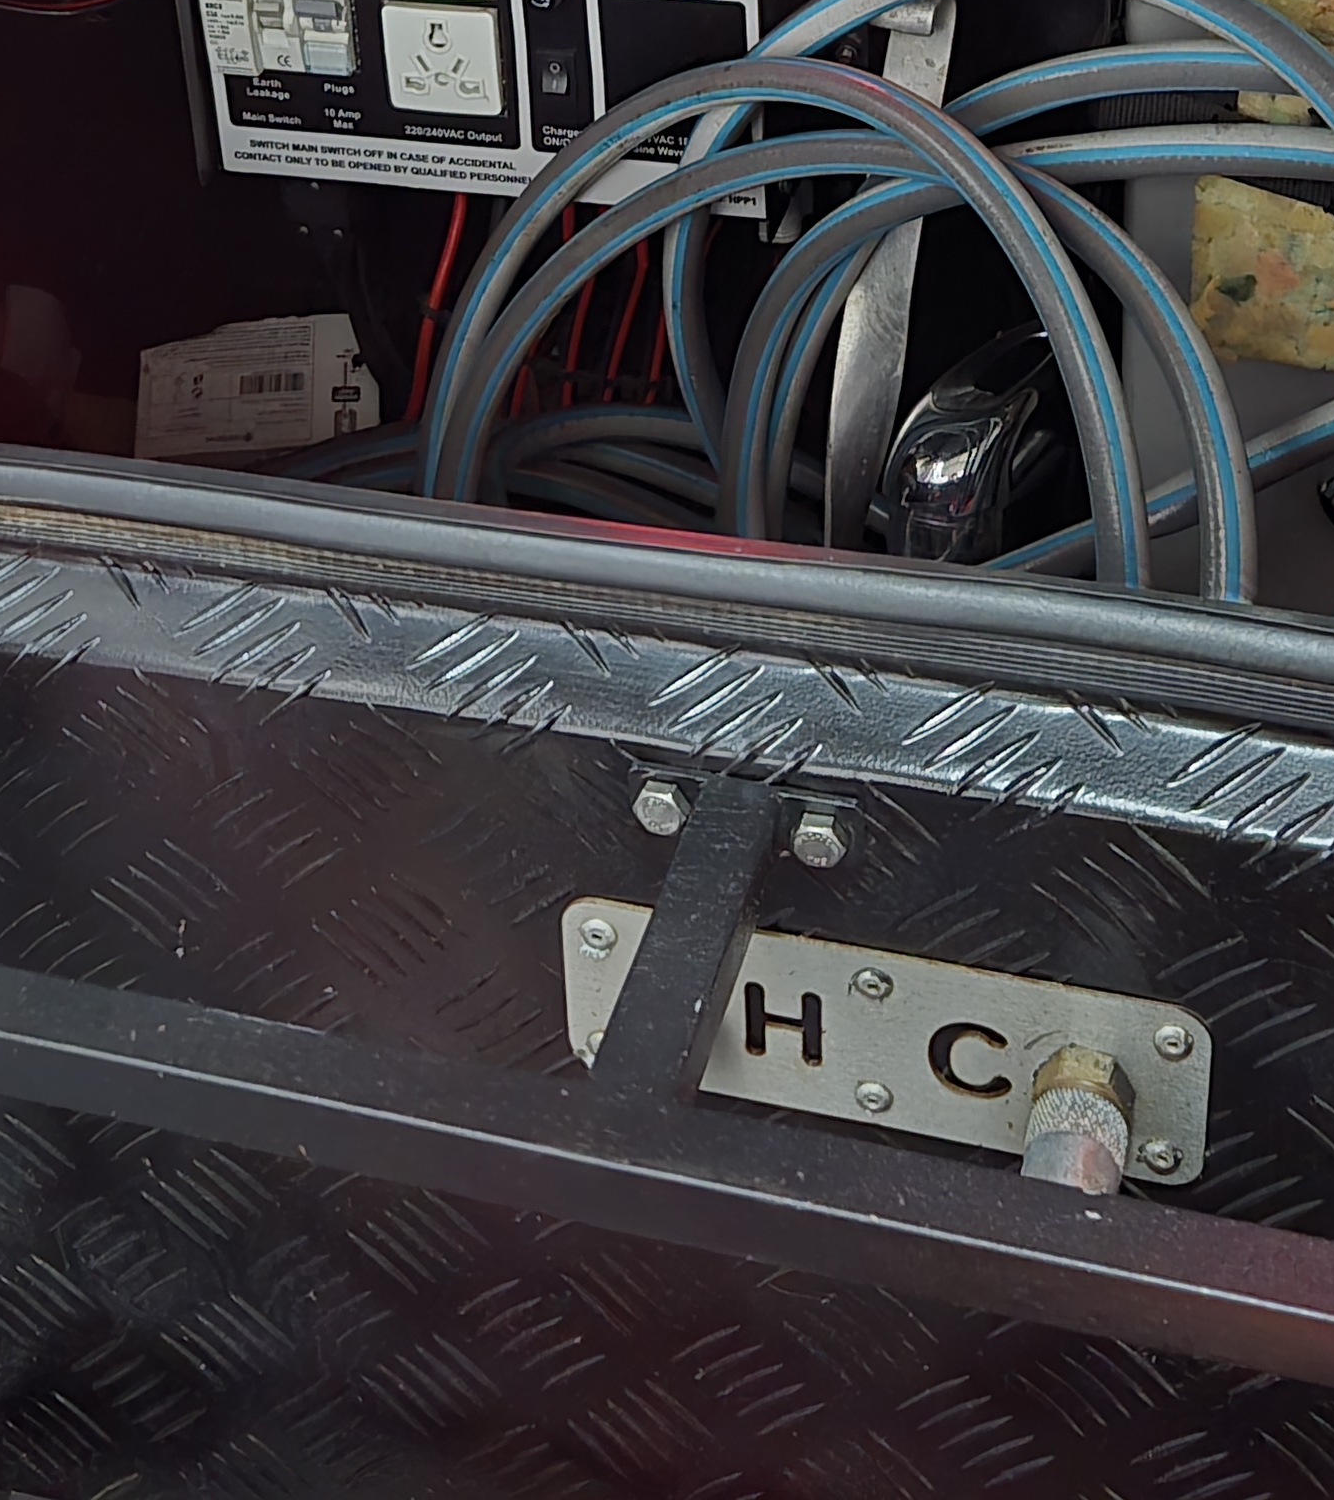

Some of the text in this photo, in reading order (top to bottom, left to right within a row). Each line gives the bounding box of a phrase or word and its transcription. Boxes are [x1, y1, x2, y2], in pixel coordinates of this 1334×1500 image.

[252, 77, 282, 88] Earth
[323, 82, 355, 96] Plugs
[246, 87, 290, 101] Leakage
[242, 111, 302, 126] Main Switch
[324, 108, 362, 121] 10 Amp
[332, 119, 355, 130] Max
[404, 125, 503, 143] 220/240VAC Output
[249, 139, 517, 171] SWITCH MAIN SWITCH OFF IN CASE OF ACCIDENTAL
[234, 150, 283, 163] CONTACT
[285, 155, 313, 166] ONLY
[314, 157, 329, 167] TO
[331, 159, 346, 168] BE
[348, 160, 392, 173] OPENED
[393, 165, 409, 174] BY
[410, 166, 467, 180] QUALIFIED
[744, 982, 1013, 1099] H C
